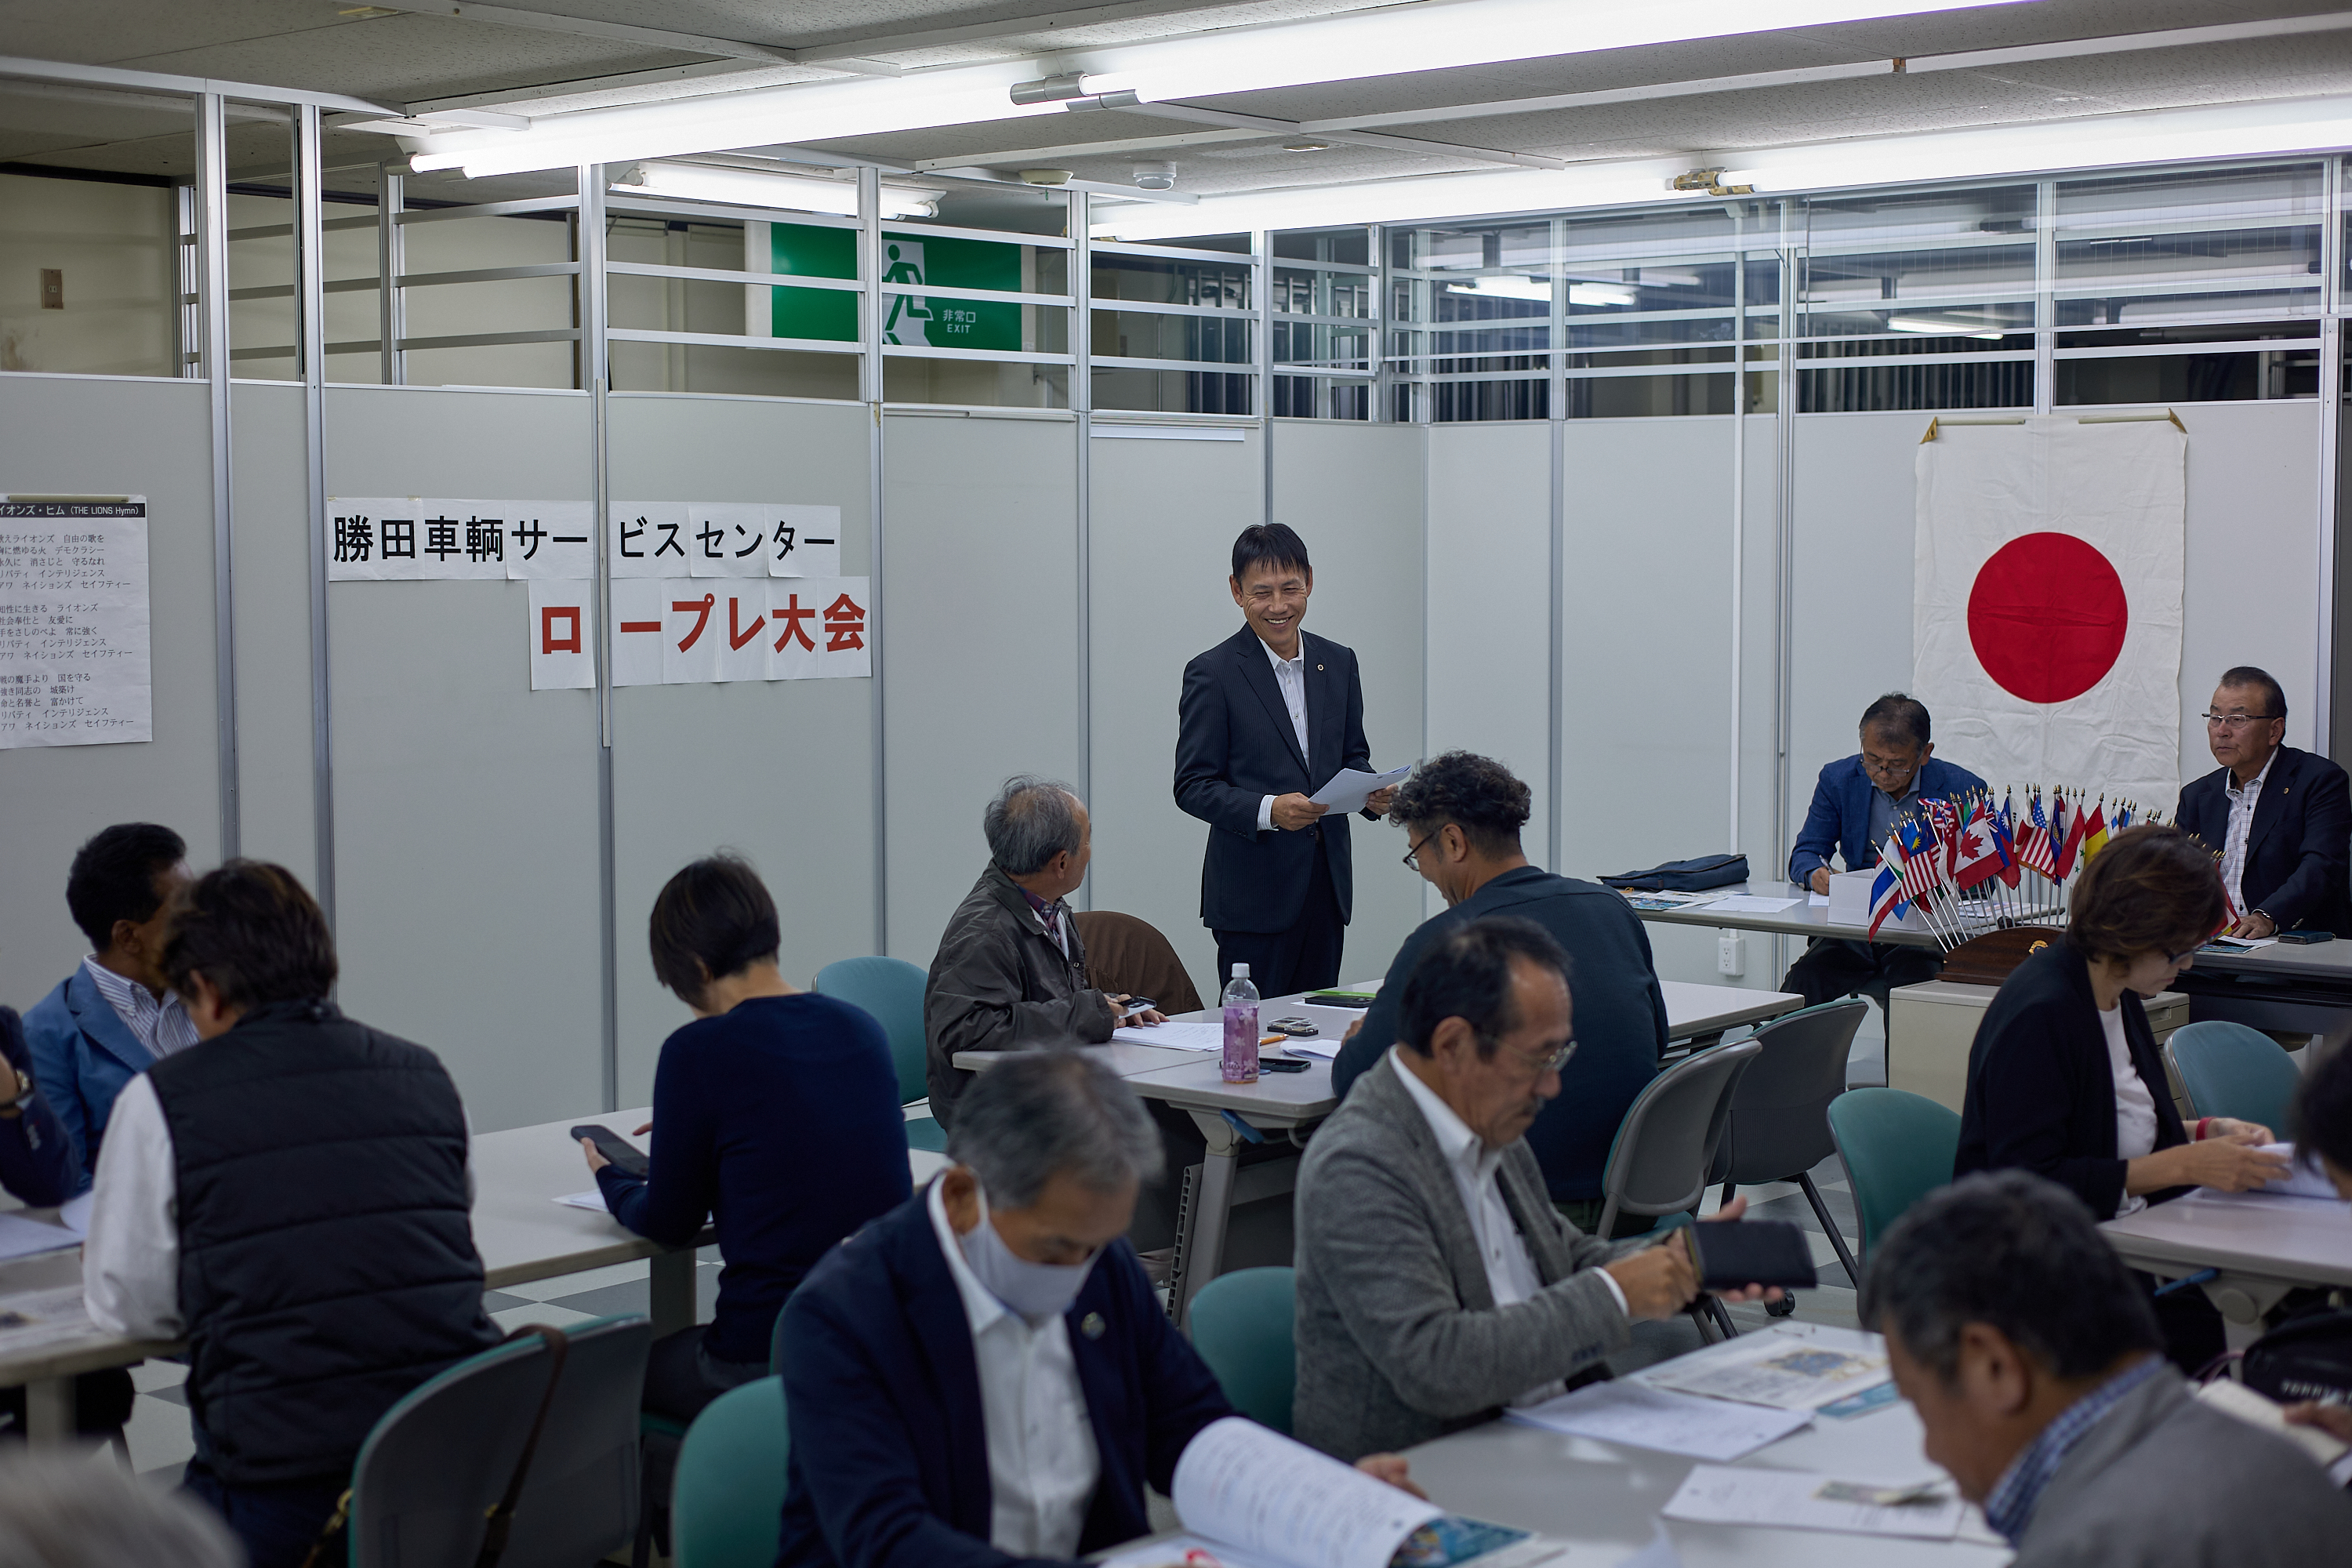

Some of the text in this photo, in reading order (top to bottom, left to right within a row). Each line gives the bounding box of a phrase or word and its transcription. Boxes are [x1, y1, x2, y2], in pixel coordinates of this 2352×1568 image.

[942, 309, 976, 323] 非常口
[947, 324, 971, 333] EXIT
[64, 534, 104, 543] 自由の歌を
[55, 546, 104, 555] デモクラシー
[39, 569, 105, 578] インテリジェンス
[23, 580, 72, 590] ネイションズ
[81, 580, 130, 589] セイフティー
[57, 603, 98, 612] ライオンズ
[49, 615, 73, 625] 友愛に
[66, 626, 97, 636] 常に強く
[41, 638, 107, 648] インテリジェンス
[24, 650, 74, 660] ネイションズ
[82, 649, 132, 659] セイフティー
[58, 673, 91, 683] 国を守る
[42, 707, 108, 718] インテリジェンス
[25, 719, 77, 731] ネイションズ
[85, 718, 134, 728] セイフティー
